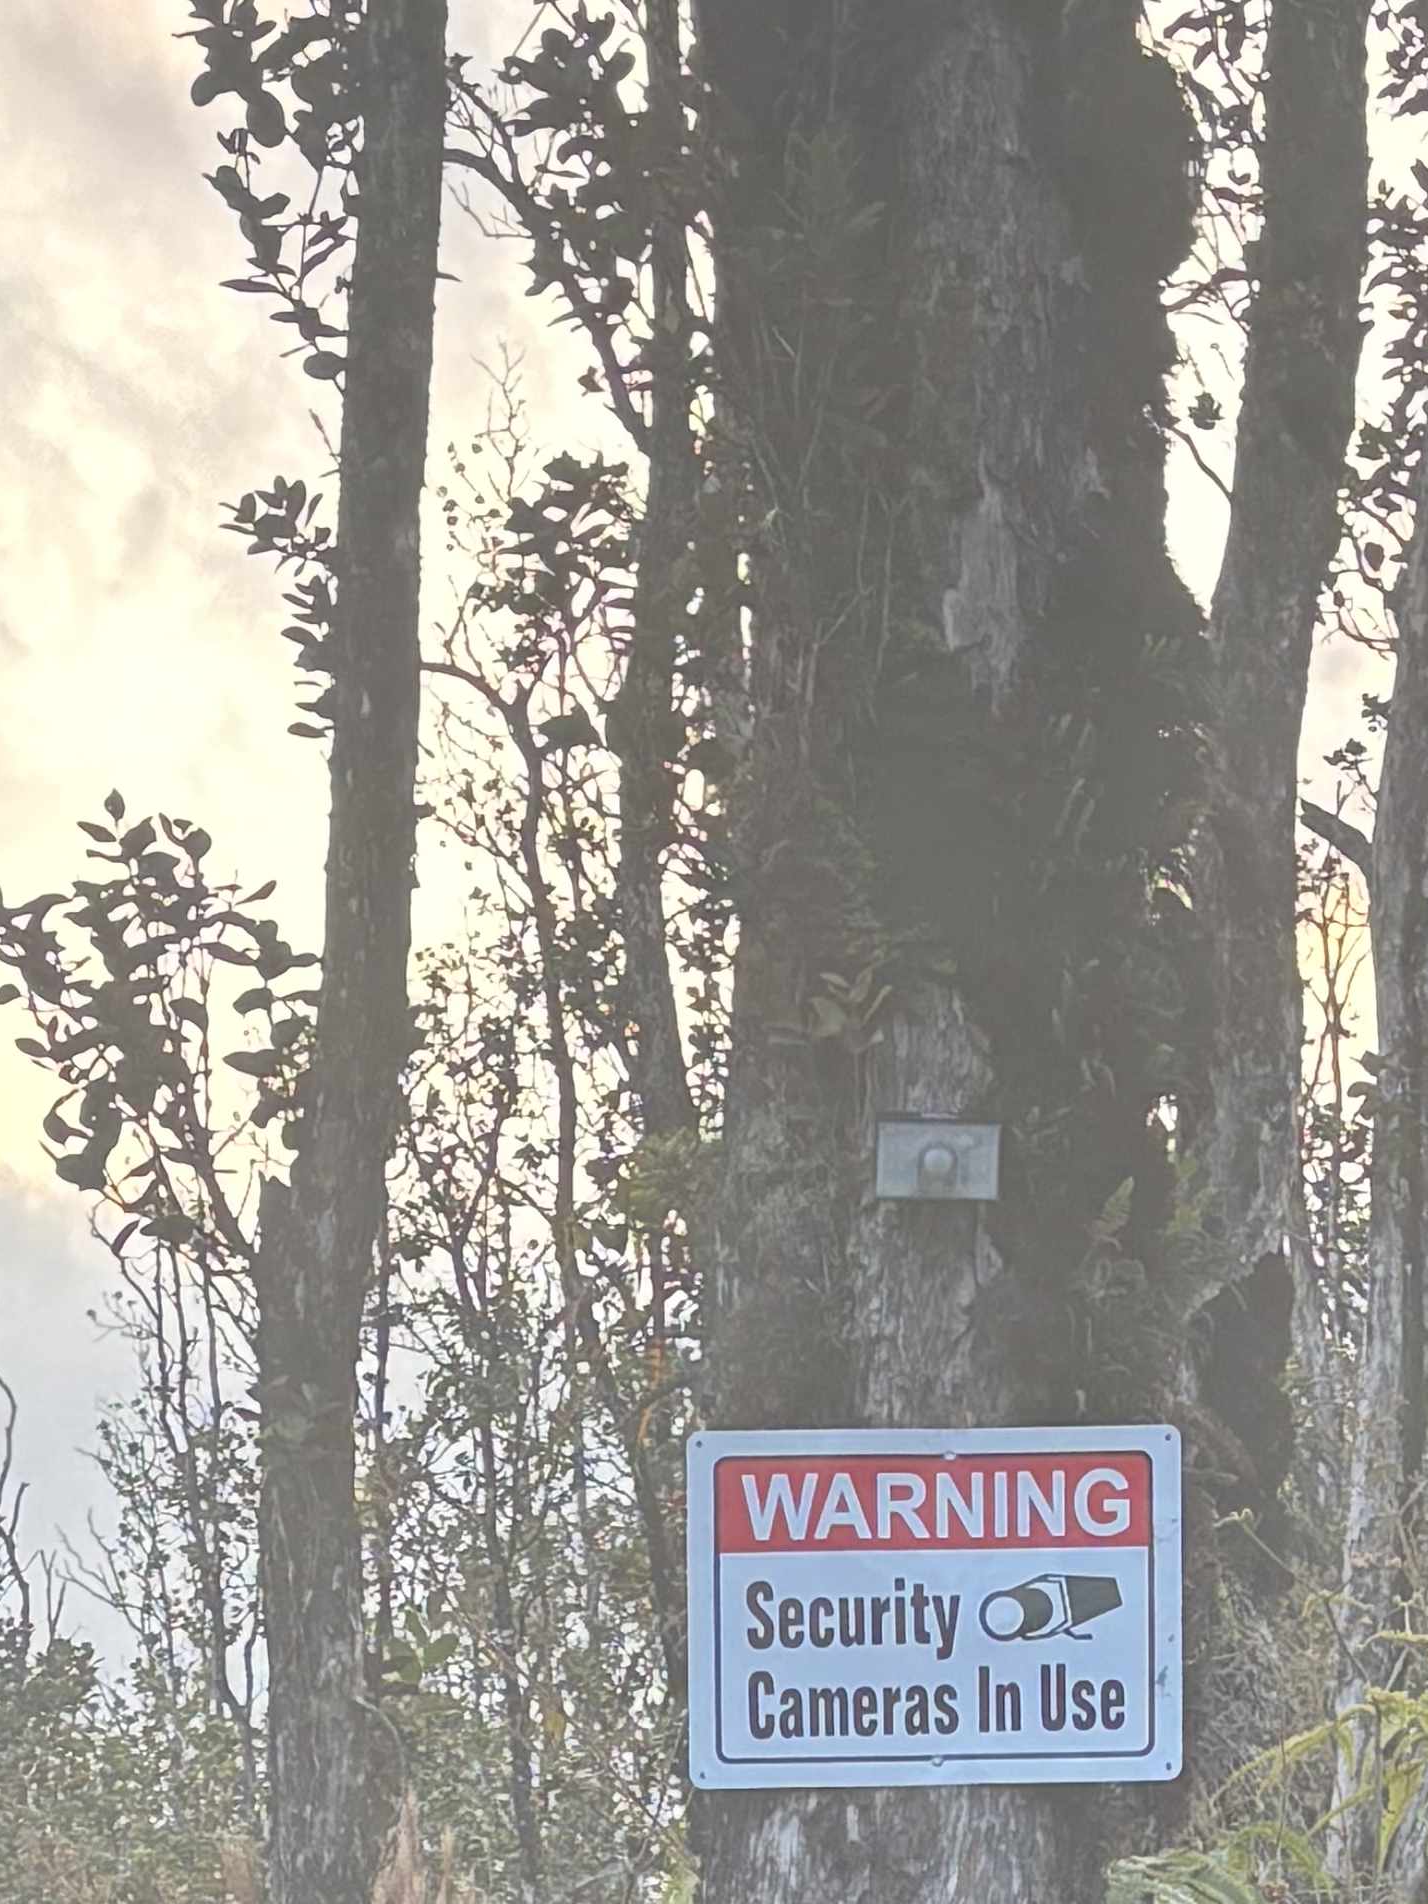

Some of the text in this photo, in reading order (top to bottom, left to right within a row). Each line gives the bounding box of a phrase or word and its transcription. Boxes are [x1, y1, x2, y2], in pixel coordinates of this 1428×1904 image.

[741, 1467, 1132, 1541] WARNING
[745, 1577, 961, 1661] Security
[747, 1663, 1126, 1740] Cameras In Use
